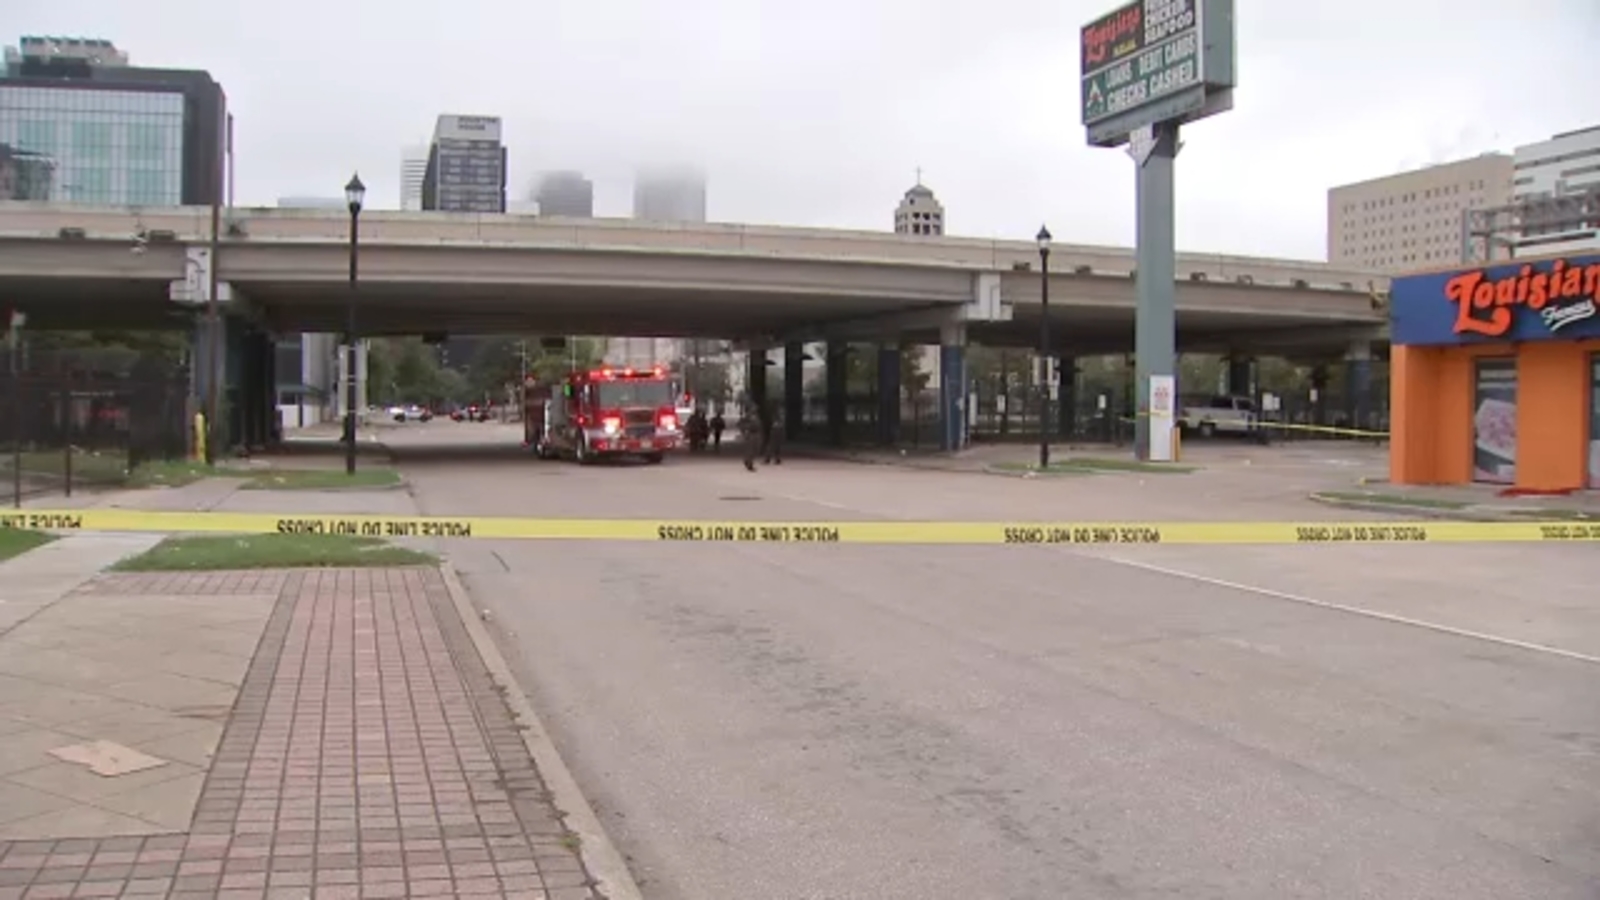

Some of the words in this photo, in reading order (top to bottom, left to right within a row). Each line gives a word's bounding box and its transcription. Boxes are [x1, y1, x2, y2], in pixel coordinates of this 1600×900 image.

[1107, 79, 1147, 112] CHECKS
[30, 514, 82, 529] POLICE
[277, 519, 324, 534] CROSS
[329, 519, 358, 535] NOT
[362, 521, 381, 535] DO
[386, 521, 418, 536] LINE
[422, 522, 471, 536] POLICE
[657, 525, 703, 541] CROSS
[707, 526, 734, 541] NOT
[737, 526, 756, 541] DO
[759, 526, 790, 541] LINE
[794, 526, 839, 542] POLICE
[1004, 527, 1044, 543] CROSS
[1047, 528, 1071, 543] NOT
[1074, 528, 1090, 543] DO
[1092, 527, 1118, 543] LINE
[1120, 527, 1161, 543] POLICE
